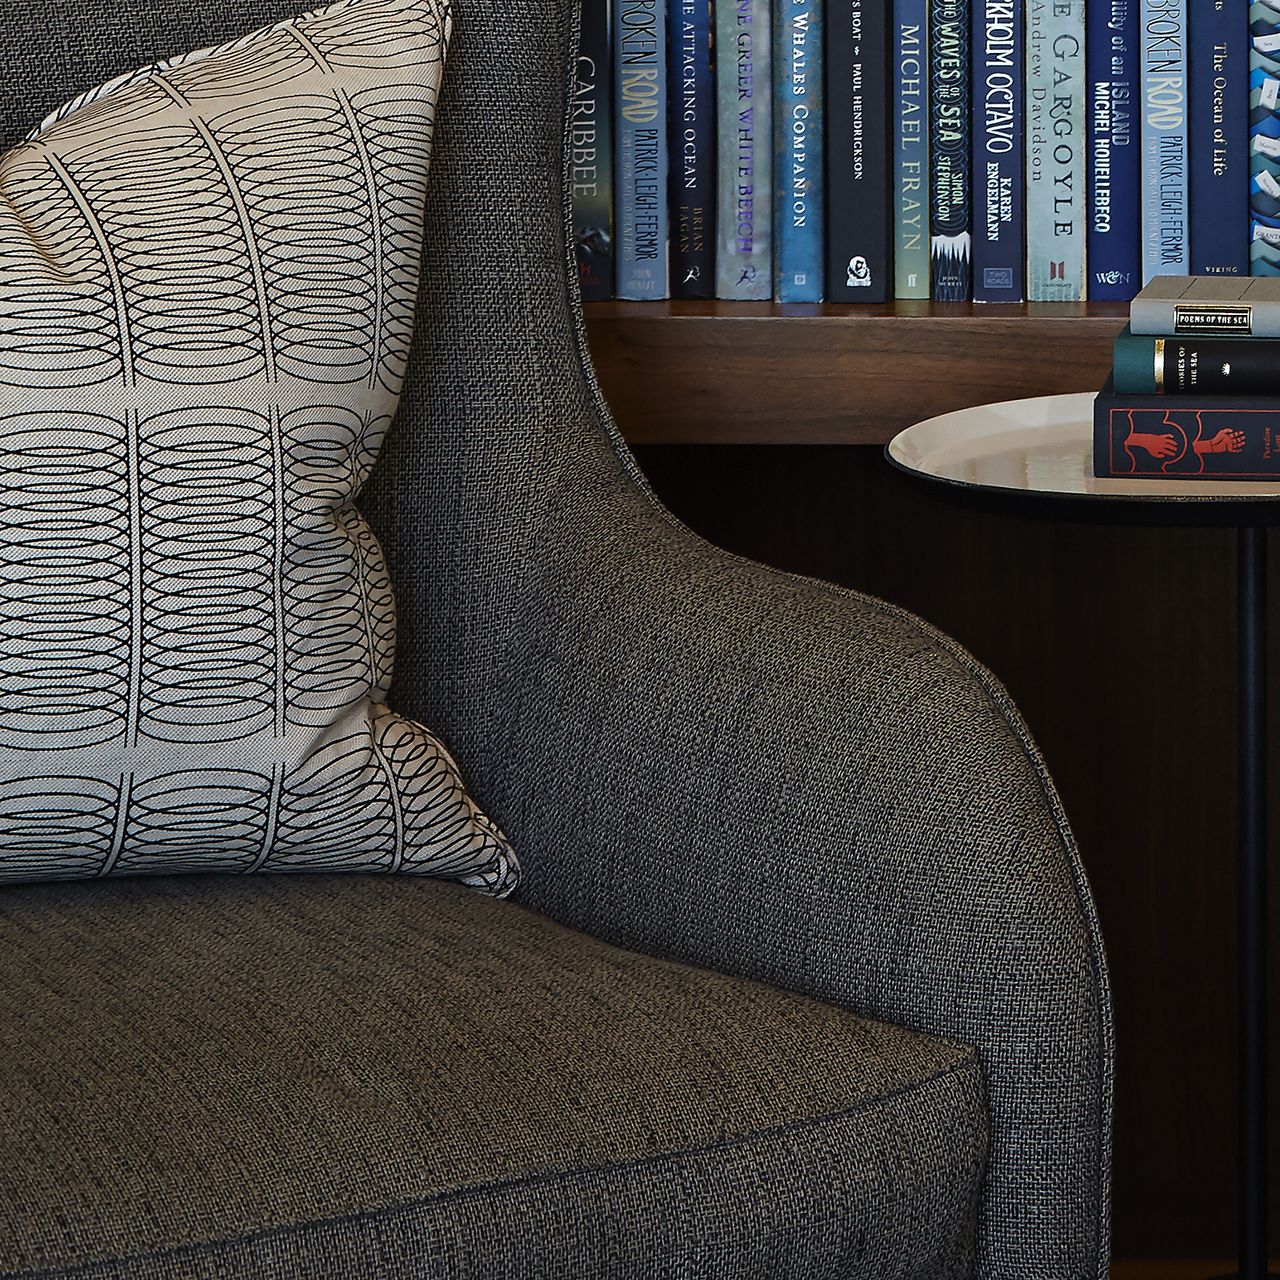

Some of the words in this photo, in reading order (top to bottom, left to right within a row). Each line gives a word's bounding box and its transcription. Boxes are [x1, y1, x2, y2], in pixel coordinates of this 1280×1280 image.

[852, 12, 861, 41] BOAT
[683, 21, 696, 121] ATTACKING
[853, 64, 862, 92] PAUL
[1214, 43, 1227, 72] The
[901, 24, 920, 150] MICHAEL
[985, 73, 1014, 153] OCTAVO
[1094, 82, 1110, 134] MICHEL
[1213, 77, 1227, 123] Ocean
[684, 129, 696, 188] OCEAN
[853, 96, 863, 179] HENDRICKSON
[1214, 129, 1227, 145] of
[1214, 149, 1227, 176] Life
[902, 161, 921, 250] FRAYN
[1094, 139, 1110, 232] HOUELLEBECQ
